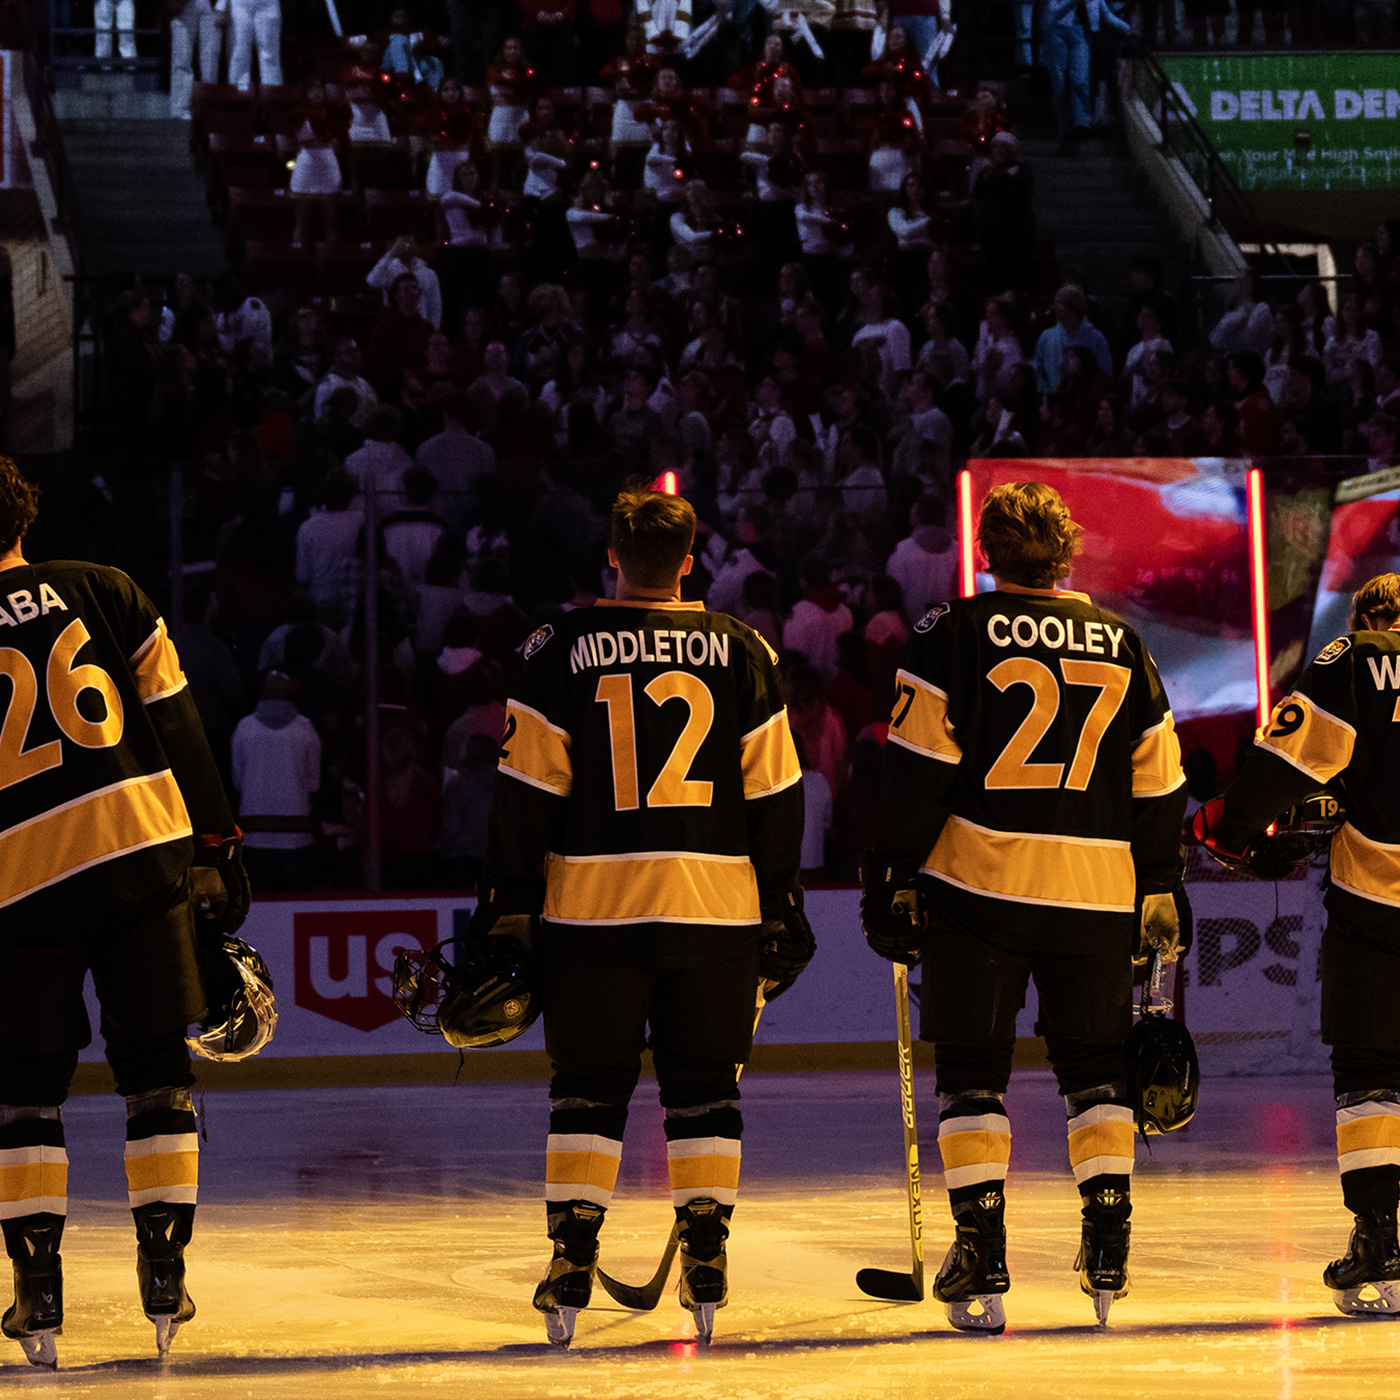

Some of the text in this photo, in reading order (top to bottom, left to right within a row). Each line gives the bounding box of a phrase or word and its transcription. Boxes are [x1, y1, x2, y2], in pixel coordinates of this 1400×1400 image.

[1210, 89, 1325, 120] DELTA
[569, 630, 729, 674] MIDDLETON
[987, 614, 1124, 658] COOLEY
[593, 669, 715, 812] 12
[984, 656, 1133, 792] 27
[1270, 704, 1304, 737] 9
[1318, 800, 1340, 819] 19
[909, 1163, 923, 1242] NEXUS
